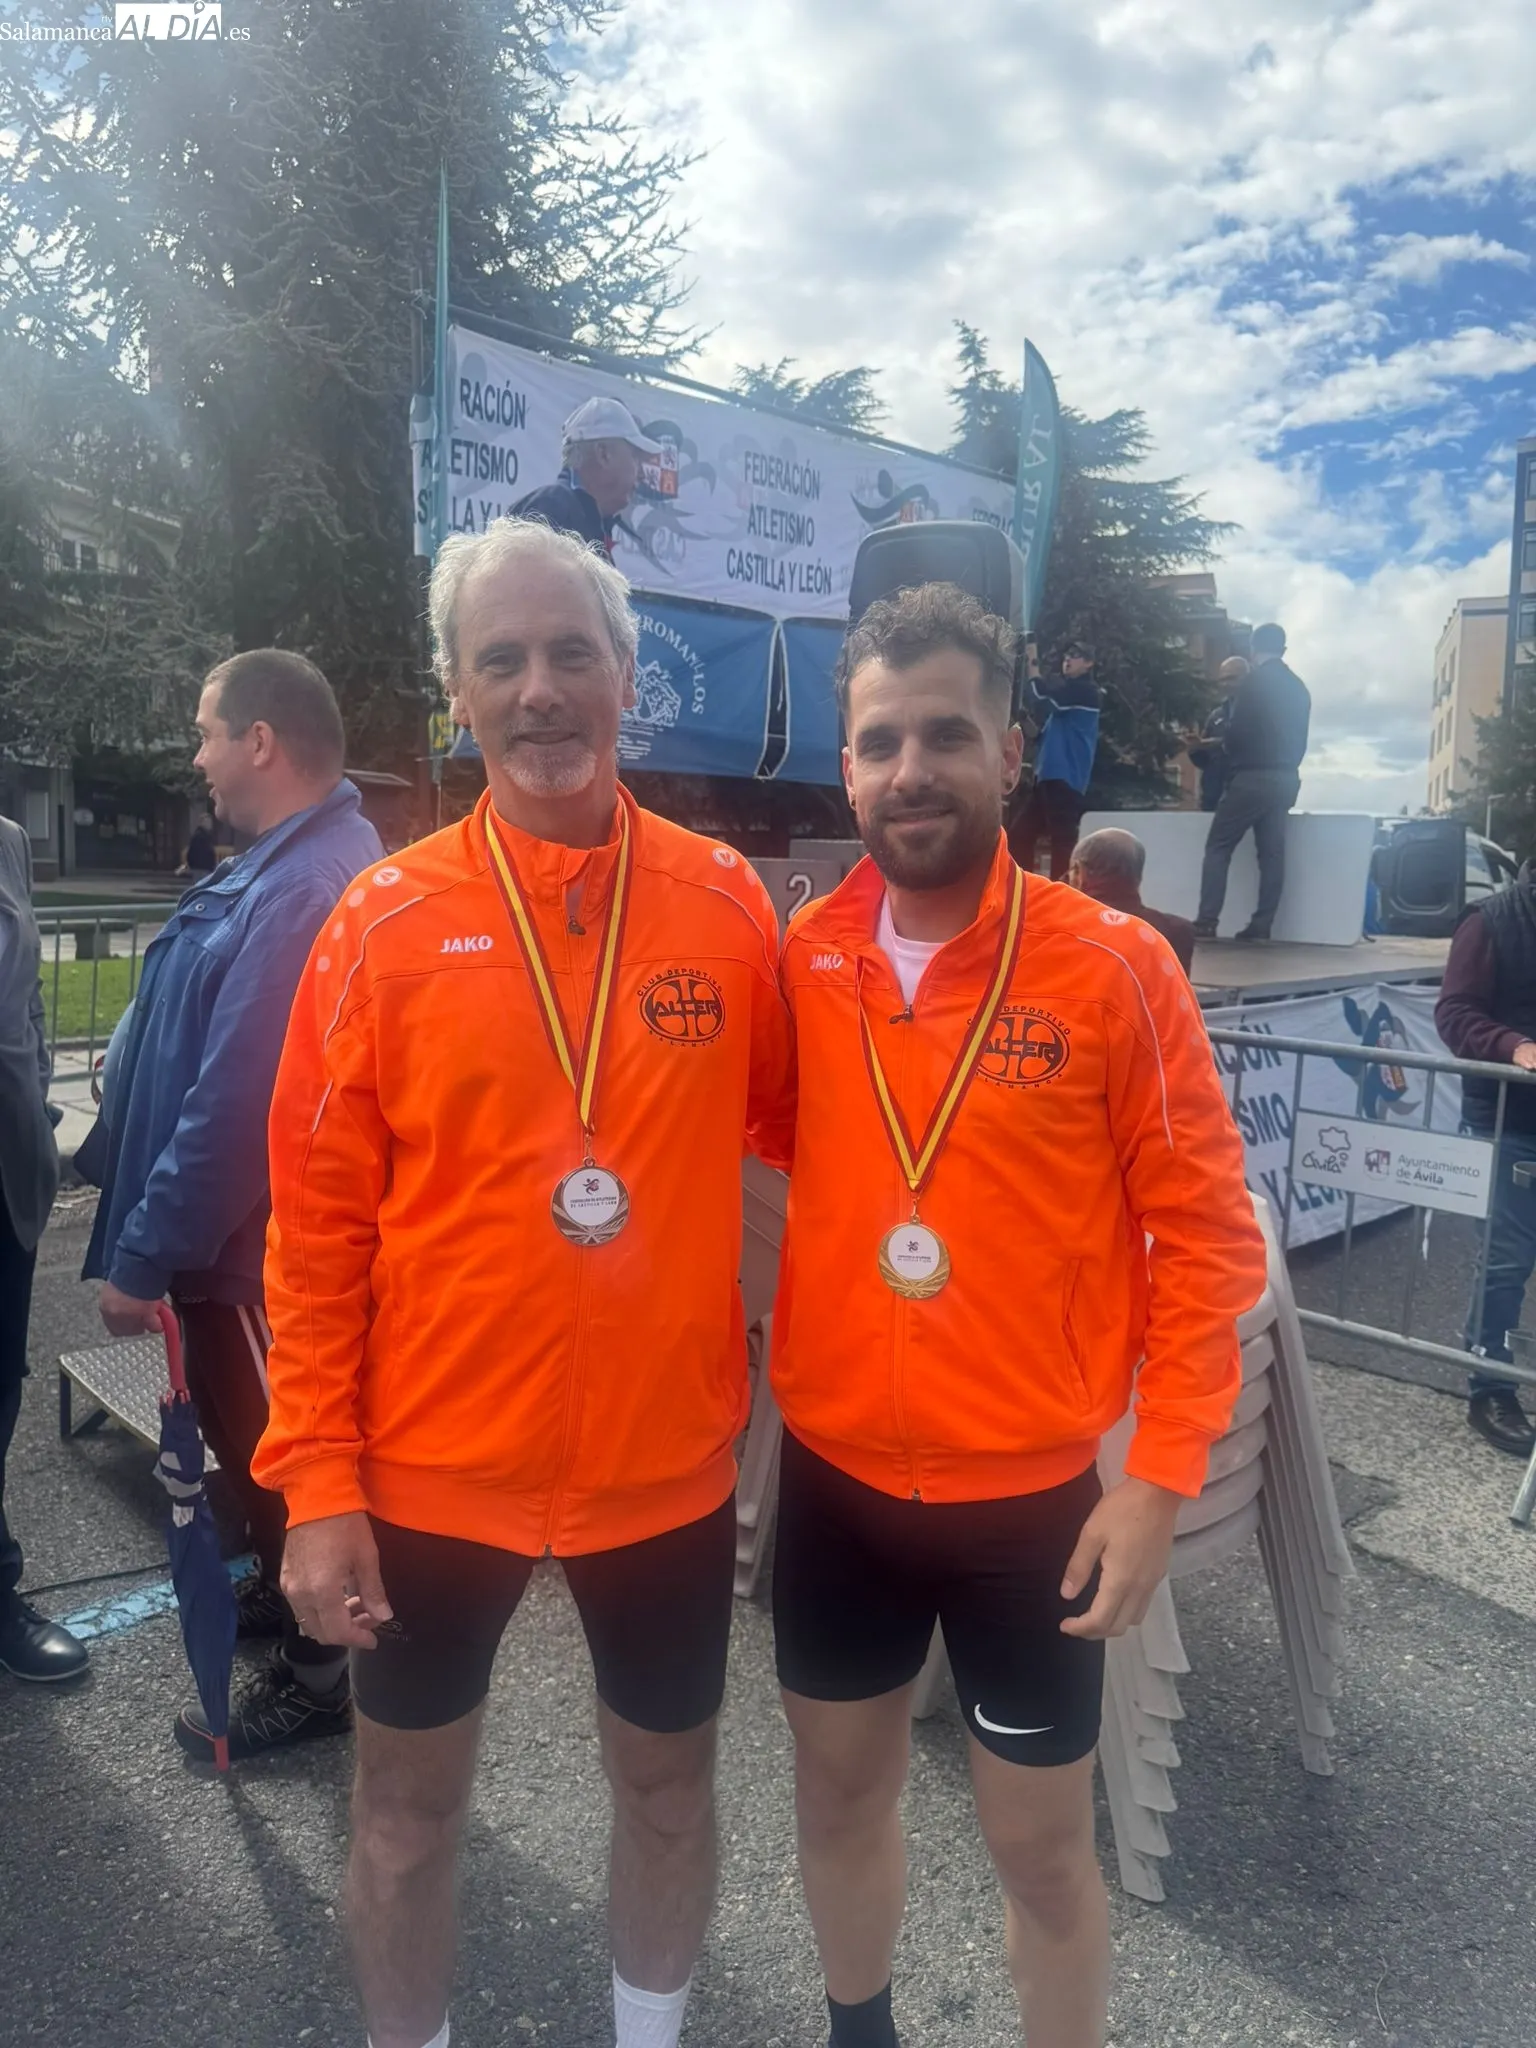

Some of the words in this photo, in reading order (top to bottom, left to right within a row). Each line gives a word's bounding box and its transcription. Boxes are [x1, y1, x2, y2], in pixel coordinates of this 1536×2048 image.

[744, 451, 820, 501] FEDERACIÓN
[747, 503, 815, 548] ATLETISMO
[727, 548, 786, 592] CASTILLA
[786, 564, 799, 592] Y
[799, 558, 832, 596] LEÓN
[787, 873, 813, 922] 2
[440, 935, 494, 954] JAKO
[810, 953, 844, 970] JAKO
[637, 973, 663, 996] CLUB
[667, 968, 722, 993] DEPORTIVO
[655, 999, 720, 1018] ALTER
[1003, 1005, 1072, 1036] DEPORTIVO
[1396, 1167, 1411, 1180] de
[1413, 1167, 1444, 1186] Ávila
[1397, 1154, 1480, 1178] Ayuntamiento
